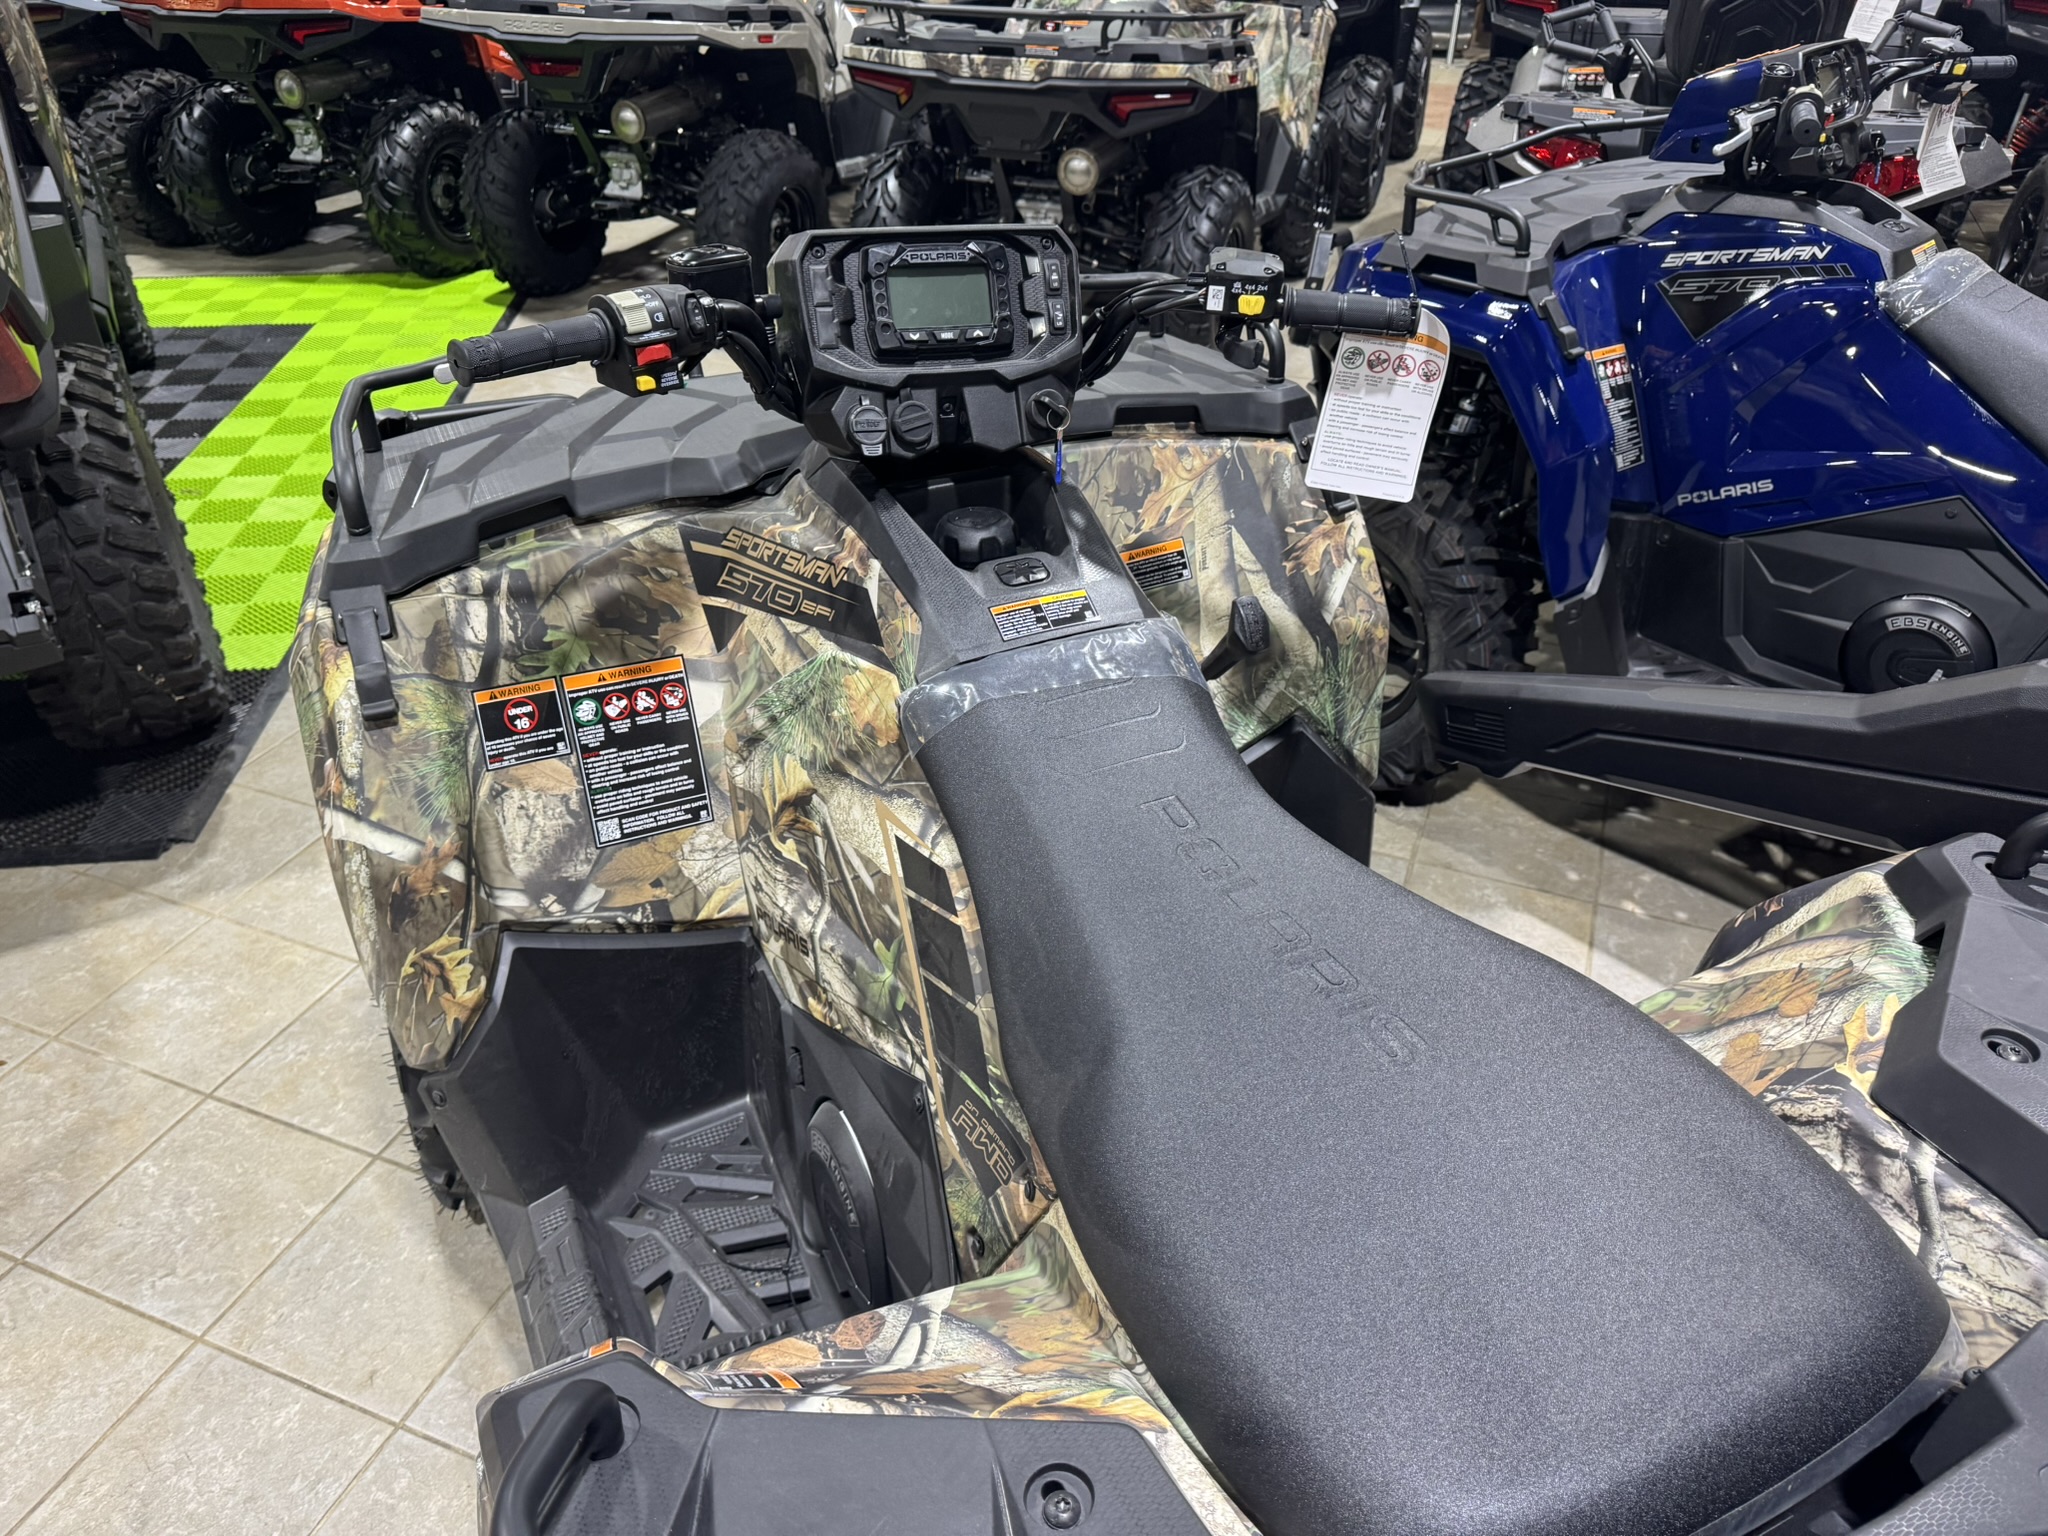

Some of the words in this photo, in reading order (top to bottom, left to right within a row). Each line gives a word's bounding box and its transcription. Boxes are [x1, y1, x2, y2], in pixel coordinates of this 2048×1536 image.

[910, 252, 967, 261] POLARIS
[1660, 245, 1832, 268] SPORTSMAN
[1668, 275, 1780, 296] 570
[1677, 478, 1774, 506] POLARIS
[720, 528, 847, 588] SPORTSMAN
[1134, 545, 1168, 559] WARNING
[716, 562, 804, 616] 570
[799, 599, 836, 622] EFI
[1889, 617, 1928, 629] EBS
[1930, 621, 1969, 654] ENGINE
[608, 665, 651, 679] WARNING
[498, 683, 540, 697] WARNING
[507, 704, 533, 716] UNDER
[513, 716, 530, 730] 16
[755, 904, 810, 958] POLARIS
[1136, 794, 1430, 1061] POLARIS
[951, 1104, 1014, 1188] AWD
[830, 1158, 858, 1226] ENGINE
